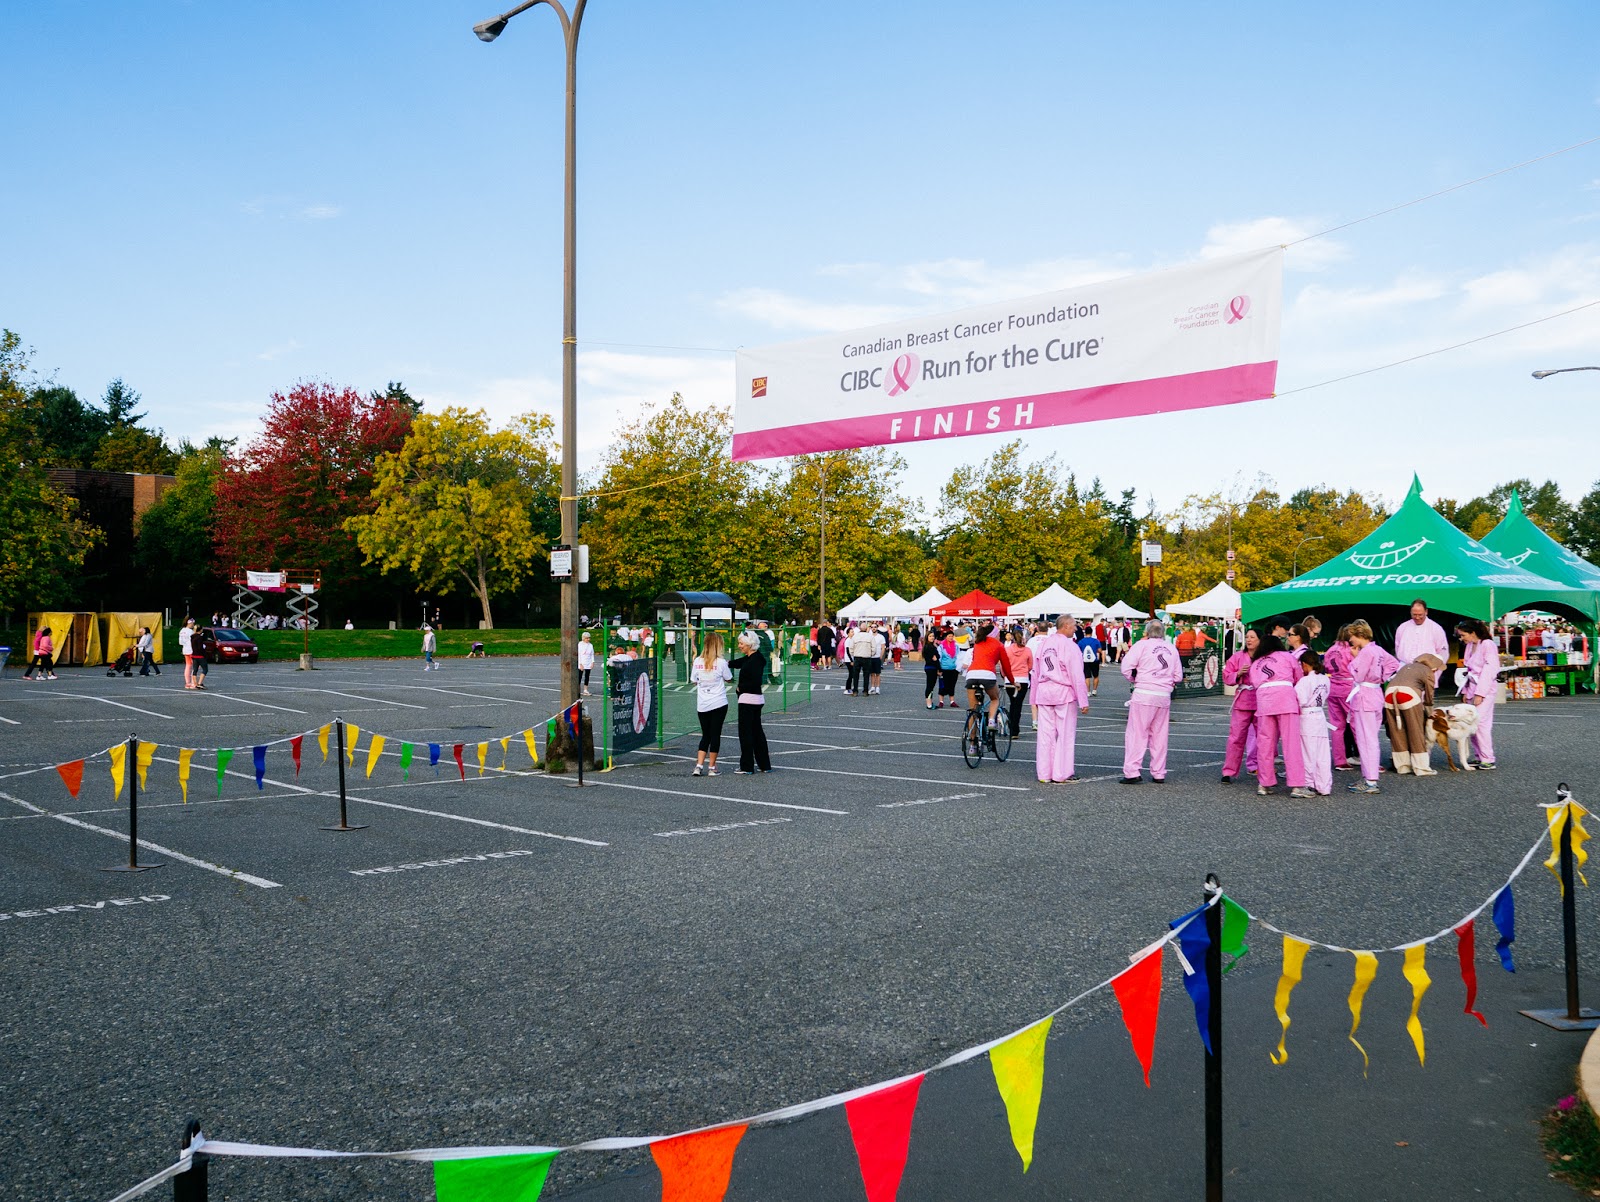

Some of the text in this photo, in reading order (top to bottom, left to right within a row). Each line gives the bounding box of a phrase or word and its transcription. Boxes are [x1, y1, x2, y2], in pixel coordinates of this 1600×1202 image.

[1195, 310, 1219, 320] Cancer
[842, 303, 1100, 358] Canadian Breast Cancer Foundation
[840, 367, 883, 392] CIBC
[922, 355, 961, 381] Run
[965, 349, 997, 375] for
[1002, 343, 1039, 370] the
[753, 378, 766, 388] CIBC
[890, 402, 1034, 440] FINISH
[1281, 574, 1457, 589] THRIFTY FOODS
[350, 850, 533, 876] RESERVED
